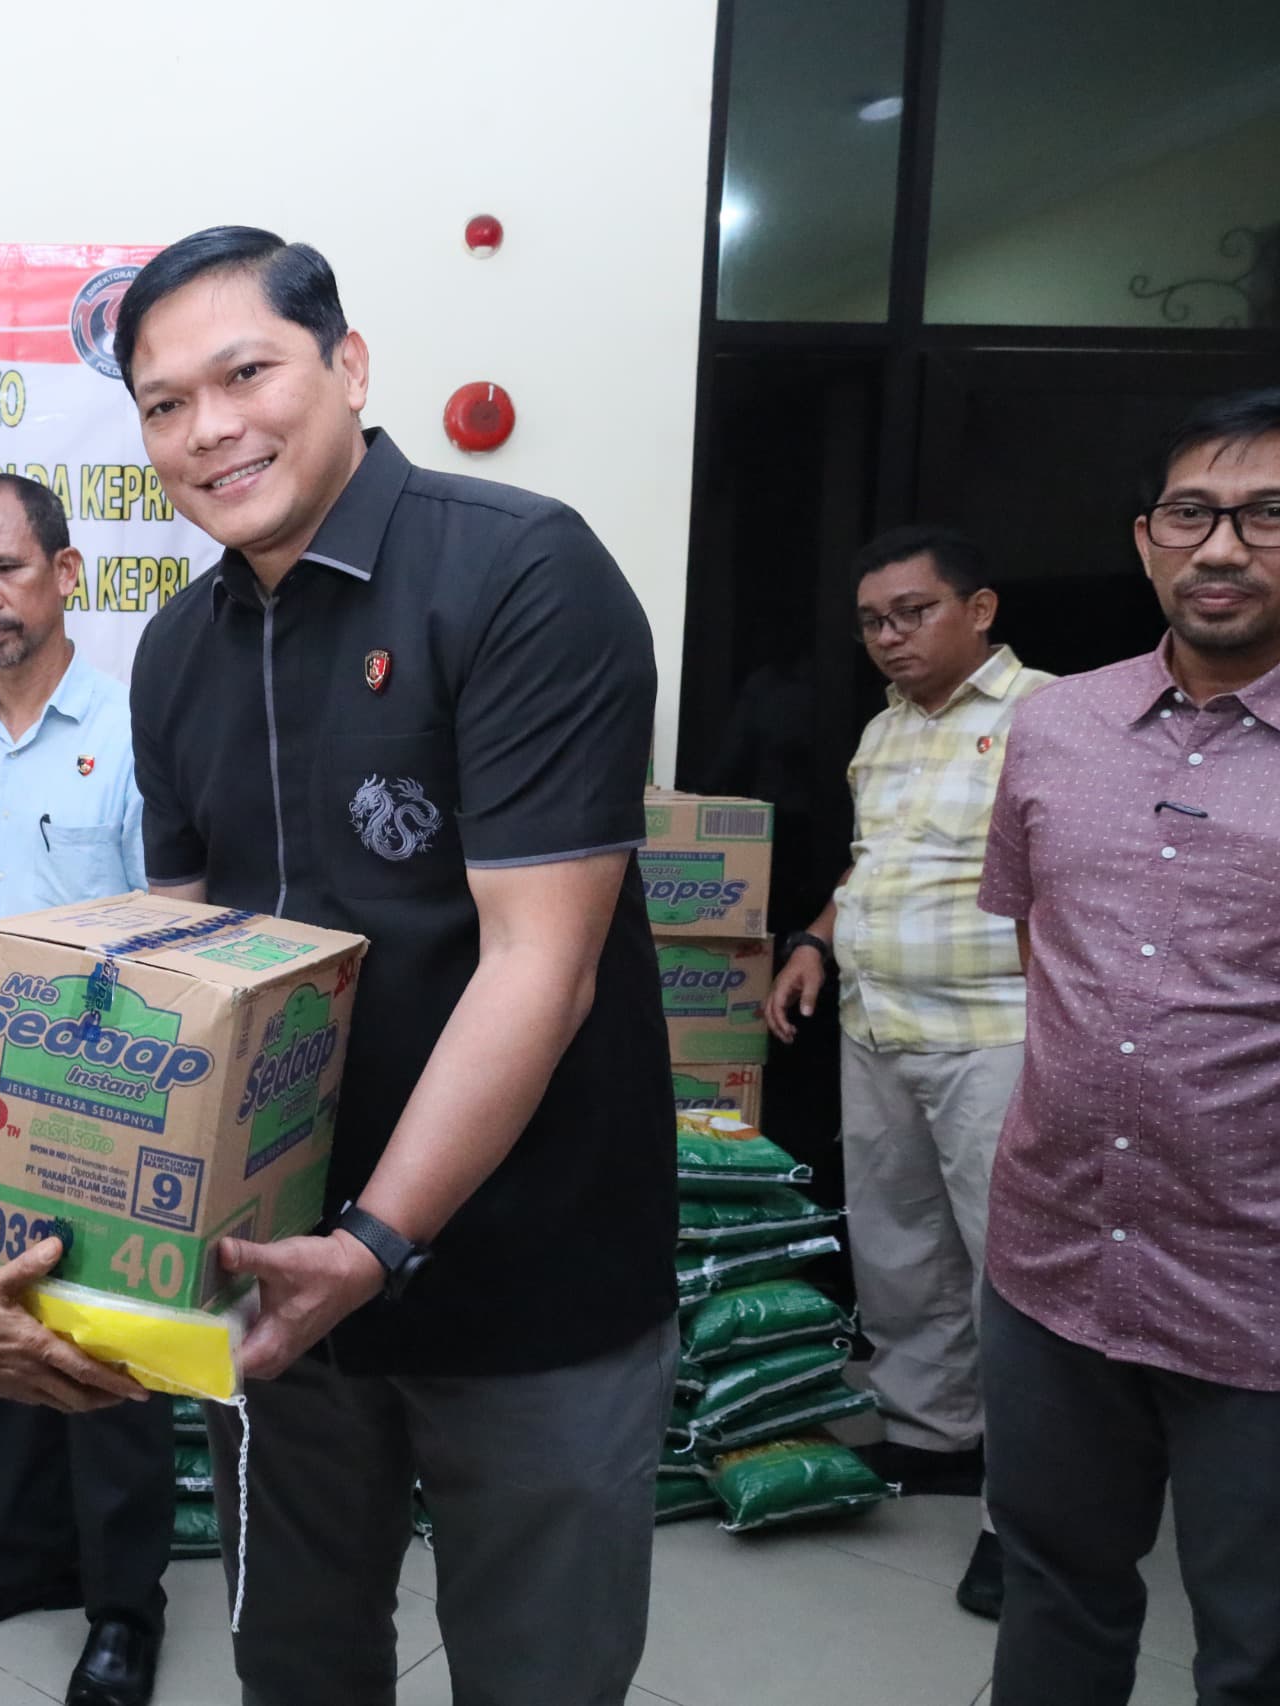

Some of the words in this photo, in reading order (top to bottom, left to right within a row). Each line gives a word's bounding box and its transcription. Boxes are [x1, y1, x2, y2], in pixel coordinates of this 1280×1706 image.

[86, 271, 137, 297] DIREKTORAT
[95, 361, 122, 377] POLD
[643, 880, 749, 907] Seda
[695, 906, 727, 919] Mie
[1, 972, 61, 1004] Mie
[661, 963, 747, 995] daap
[65, 1065, 148, 1102] Instant
[237, 1022, 339, 1125] Sedaap
[4, 1081, 40, 1101] JELAS
[43, 1088, 88, 1113] TERASA
[91, 1101, 156, 1129] SEDAPNYA
[30, 1118, 70, 1144] RASA
[71, 1129, 114, 1154] SOTO
[143, 1159, 197, 1178] MAKSIMUM
[144, 1152, 198, 1171] TUMPUKAN
[37, 1167, 78, 1187] PRAKARSA
[78, 1178, 101, 1193] ALAM
[101, 1185, 127, 1200] SEGAR
[151, 1172, 183, 1212] 9
[110, 1233, 184, 1299] 40
